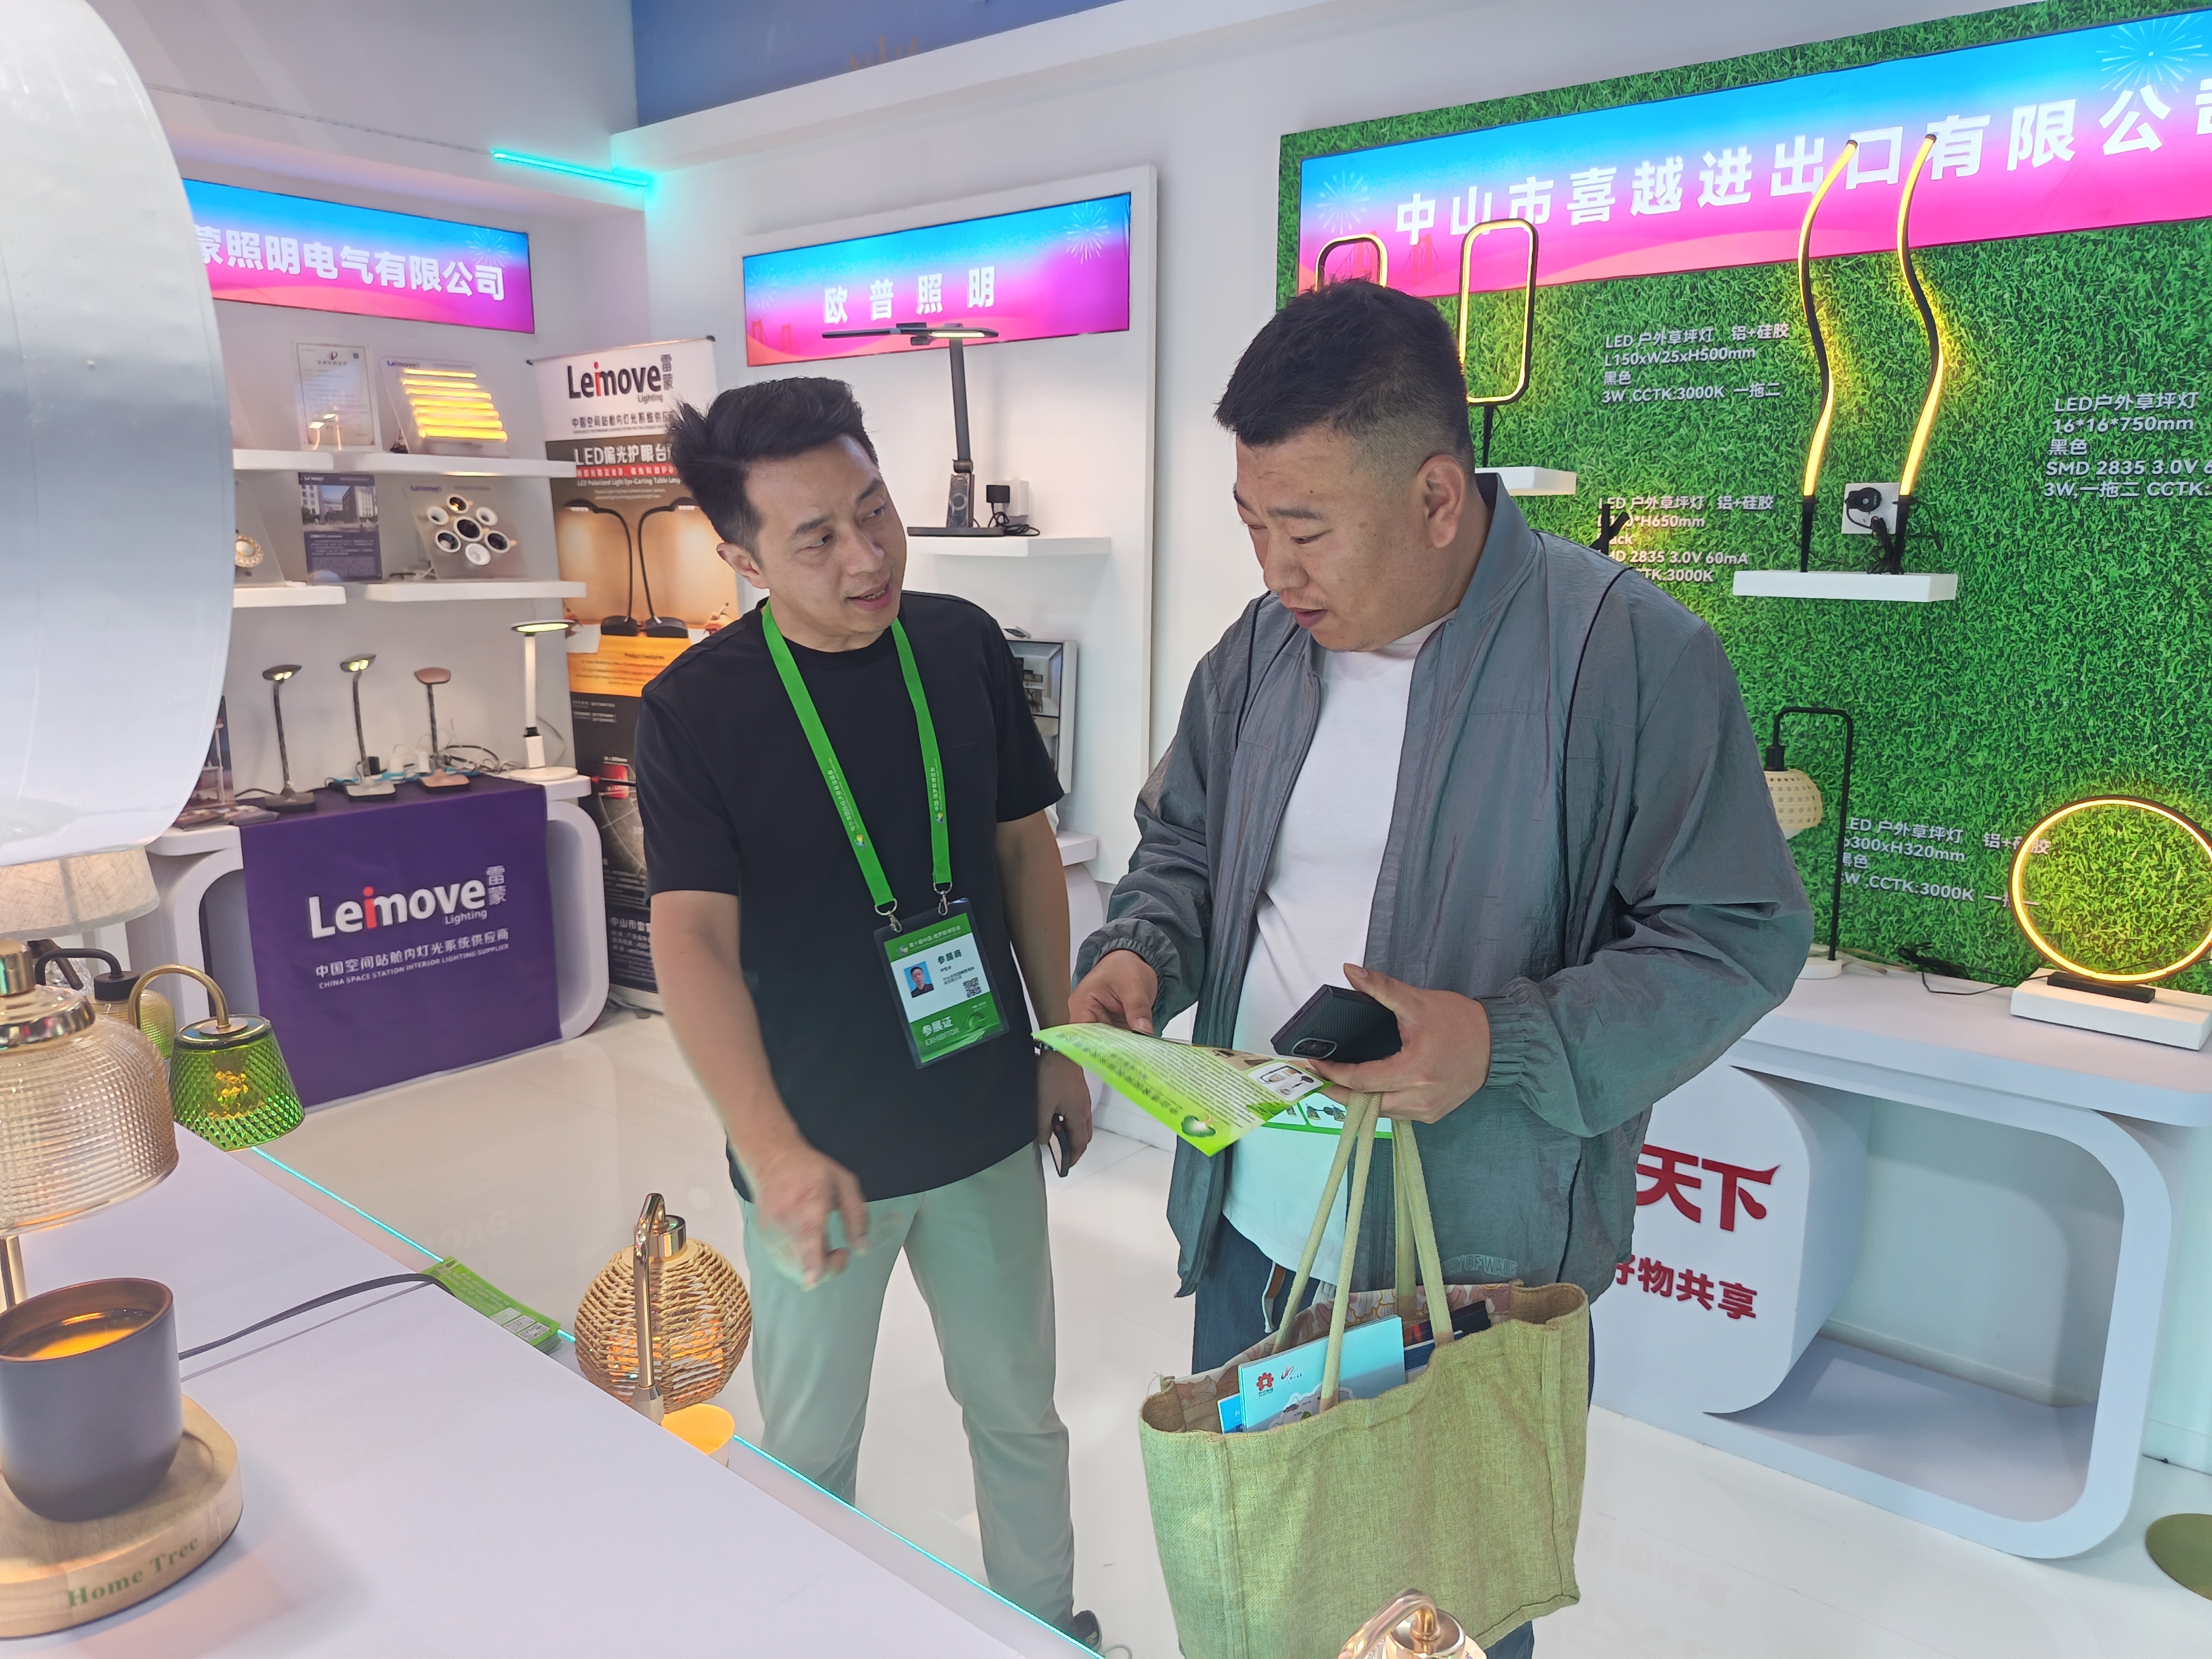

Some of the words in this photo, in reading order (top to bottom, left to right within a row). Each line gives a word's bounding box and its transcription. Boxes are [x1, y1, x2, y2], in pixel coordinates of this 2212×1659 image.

[1395, 78, 2212, 245] 中山市喜越进出口有限公
[194, 223, 504, 300] 蒙照明电气有限公司
[823, 265, 995, 325] 欧普照明
[1605, 335, 1633, 348] LED
[1637, 327, 1714, 348] 户外草坪灯
[1731, 323, 1790, 342] 铝+硅胶
[1605, 346, 1756, 367] L150xW25xH500mm
[567, 362, 661, 399] Leimove
[1603, 371, 1631, 386] 黑色
[638, 394, 664, 404] Lighting
[1603, 389, 1625, 403] 3W
[1733, 383, 1781, 399] 一拖二
[2054, 391, 2199, 413] LED户外草坪灯
[2048, 438, 2088, 456] 黑色
[2046, 461, 2090, 476] SMD
[2096, 460, 2145, 475] 2835
[2151, 459, 2199, 474] 3.0V
[1630, 495, 1705, 510] 户外草坪灯
[1717, 495, 1775, 510] 铝+硅胶
[1630, 550, 1666, 564] 2835
[1669, 551, 1703, 564] 3.0V
[1705, 552, 1749, 565] 60mA
[1845, 817, 1872, 831] ED
[1876, 820, 1963, 844] 户外草坪灯
[487, 865, 507, 906] 雷蒙
[1841, 872, 1861, 885] W
[309, 879, 486, 939] Leimove
[444, 909, 487, 926] Lighting
[316, 928, 509, 978] 中国空间站舱内灯光系统供应商
[319, 978, 345, 990] CHINA
[346, 973, 371, 984] SPACE
[372, 967, 405, 979] STATION
[406, 958, 441, 972] INTERIOR
[922, 1015, 953, 1037] 参展证
[925, 1027, 960, 1046] EXHIBITOR
[1636, 1144, 1781, 1232] 天下
[1464, 1254, 1484, 1271] OF
[1483, 1255, 1518, 1278] WADE
[67, 1570, 144, 1608] Home
[149, 1537, 199, 1574] Tree
